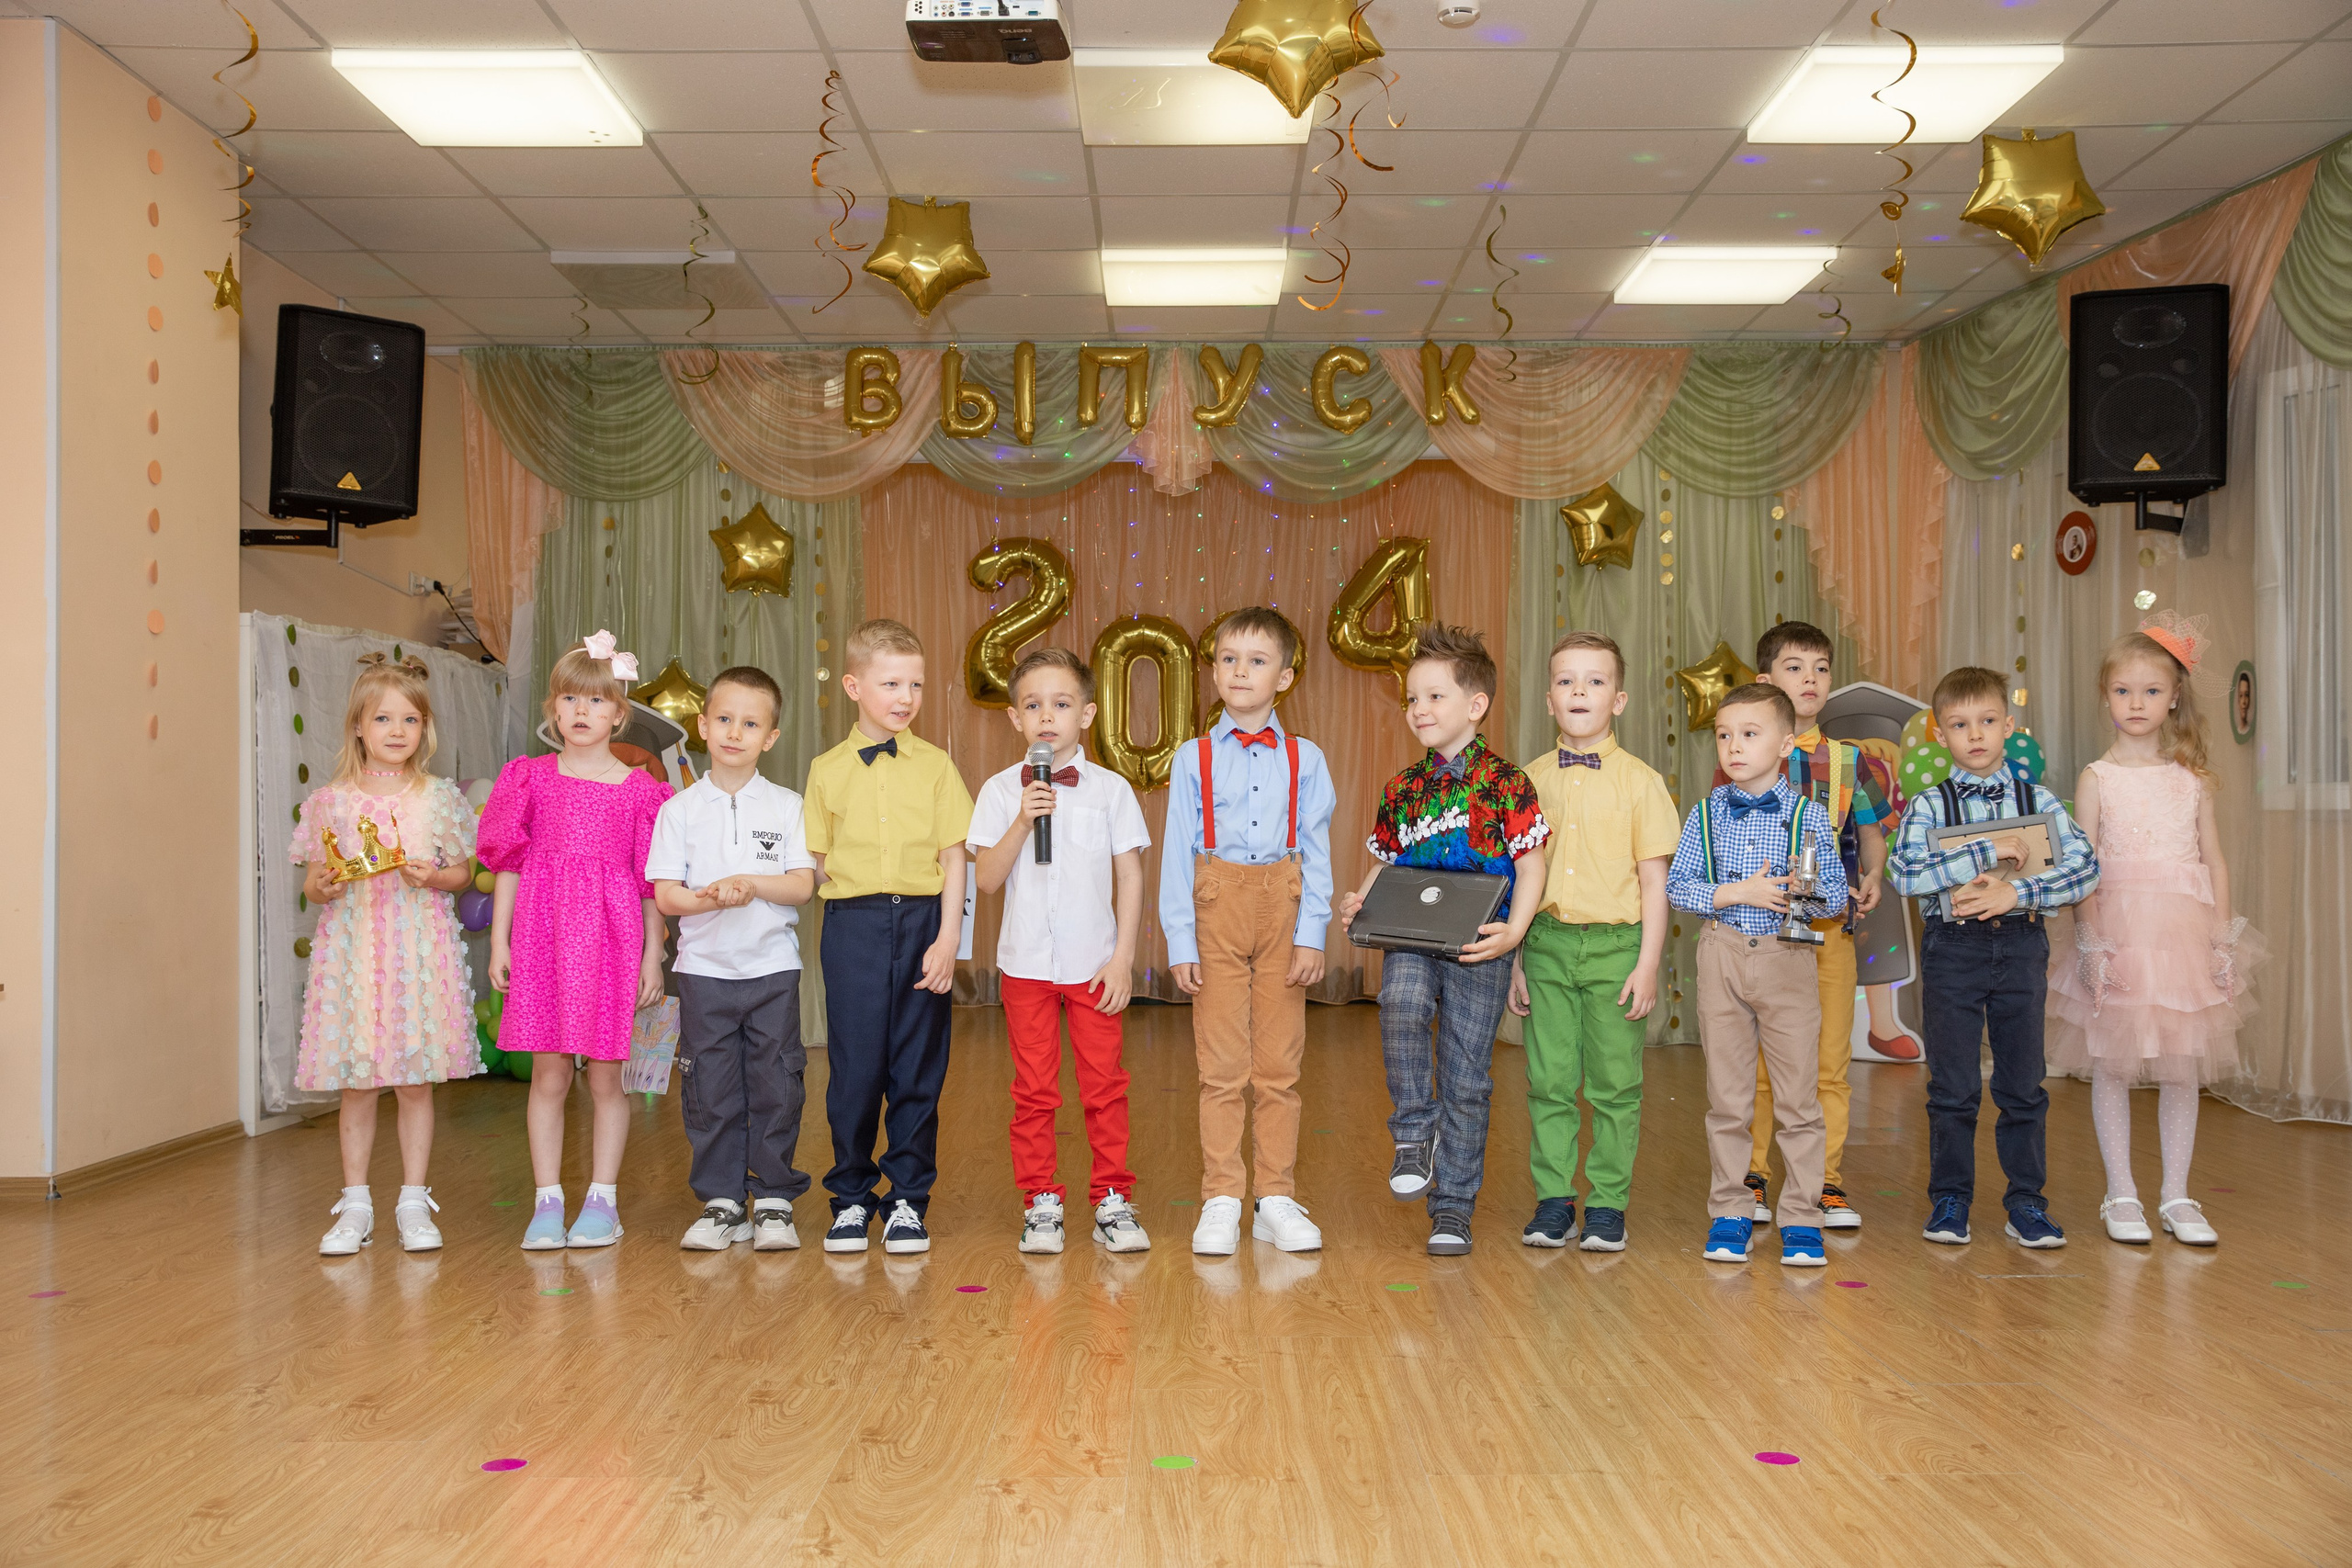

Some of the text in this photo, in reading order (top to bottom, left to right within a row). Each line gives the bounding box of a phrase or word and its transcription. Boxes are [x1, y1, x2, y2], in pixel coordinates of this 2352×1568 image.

[843, 339, 1481, 446] ВЫПУСК
[752, 830, 783, 841] EMPORIO
[756, 852, 779, 863] ARMANI
